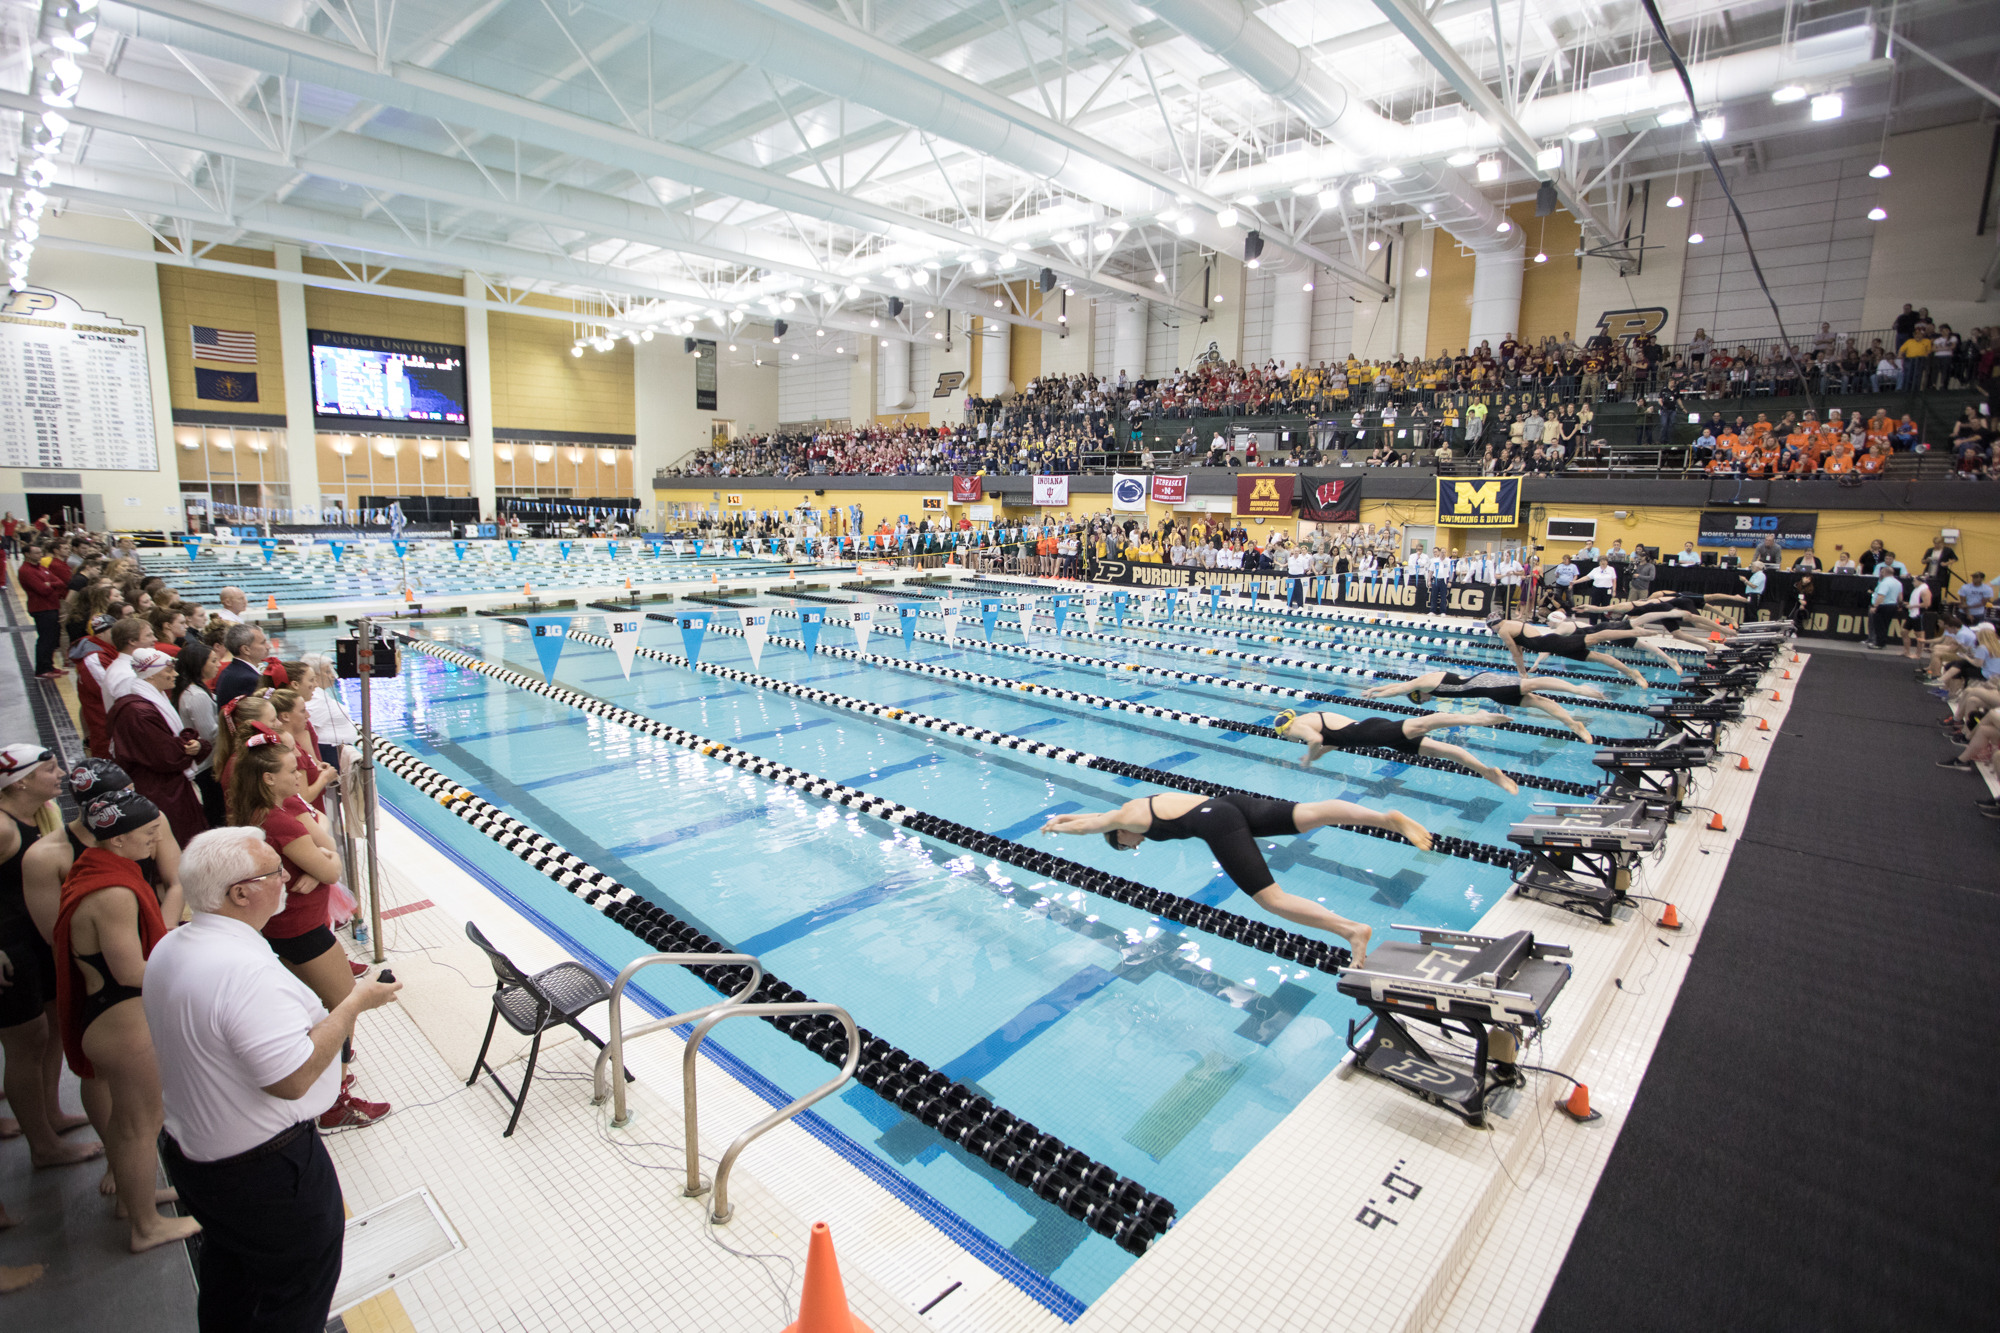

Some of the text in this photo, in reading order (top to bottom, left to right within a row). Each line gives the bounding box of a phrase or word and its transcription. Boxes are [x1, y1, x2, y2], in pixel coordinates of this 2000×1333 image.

[77, 333, 126, 344] WOMEN
[322, 333, 452, 355] PURDUE UNIVERSITY
[1036, 477, 1063, 485] INDIANA
[1155, 478, 1182, 487] NEBRASKA
[1250, 479, 1280, 500] M
[1454, 481, 1501, 514] M
[1440, 515, 1513, 523] SWIMMING & DIVING
[1132, 566, 1190, 587] PURDUE
[1347, 582, 1417, 606] DIVING
